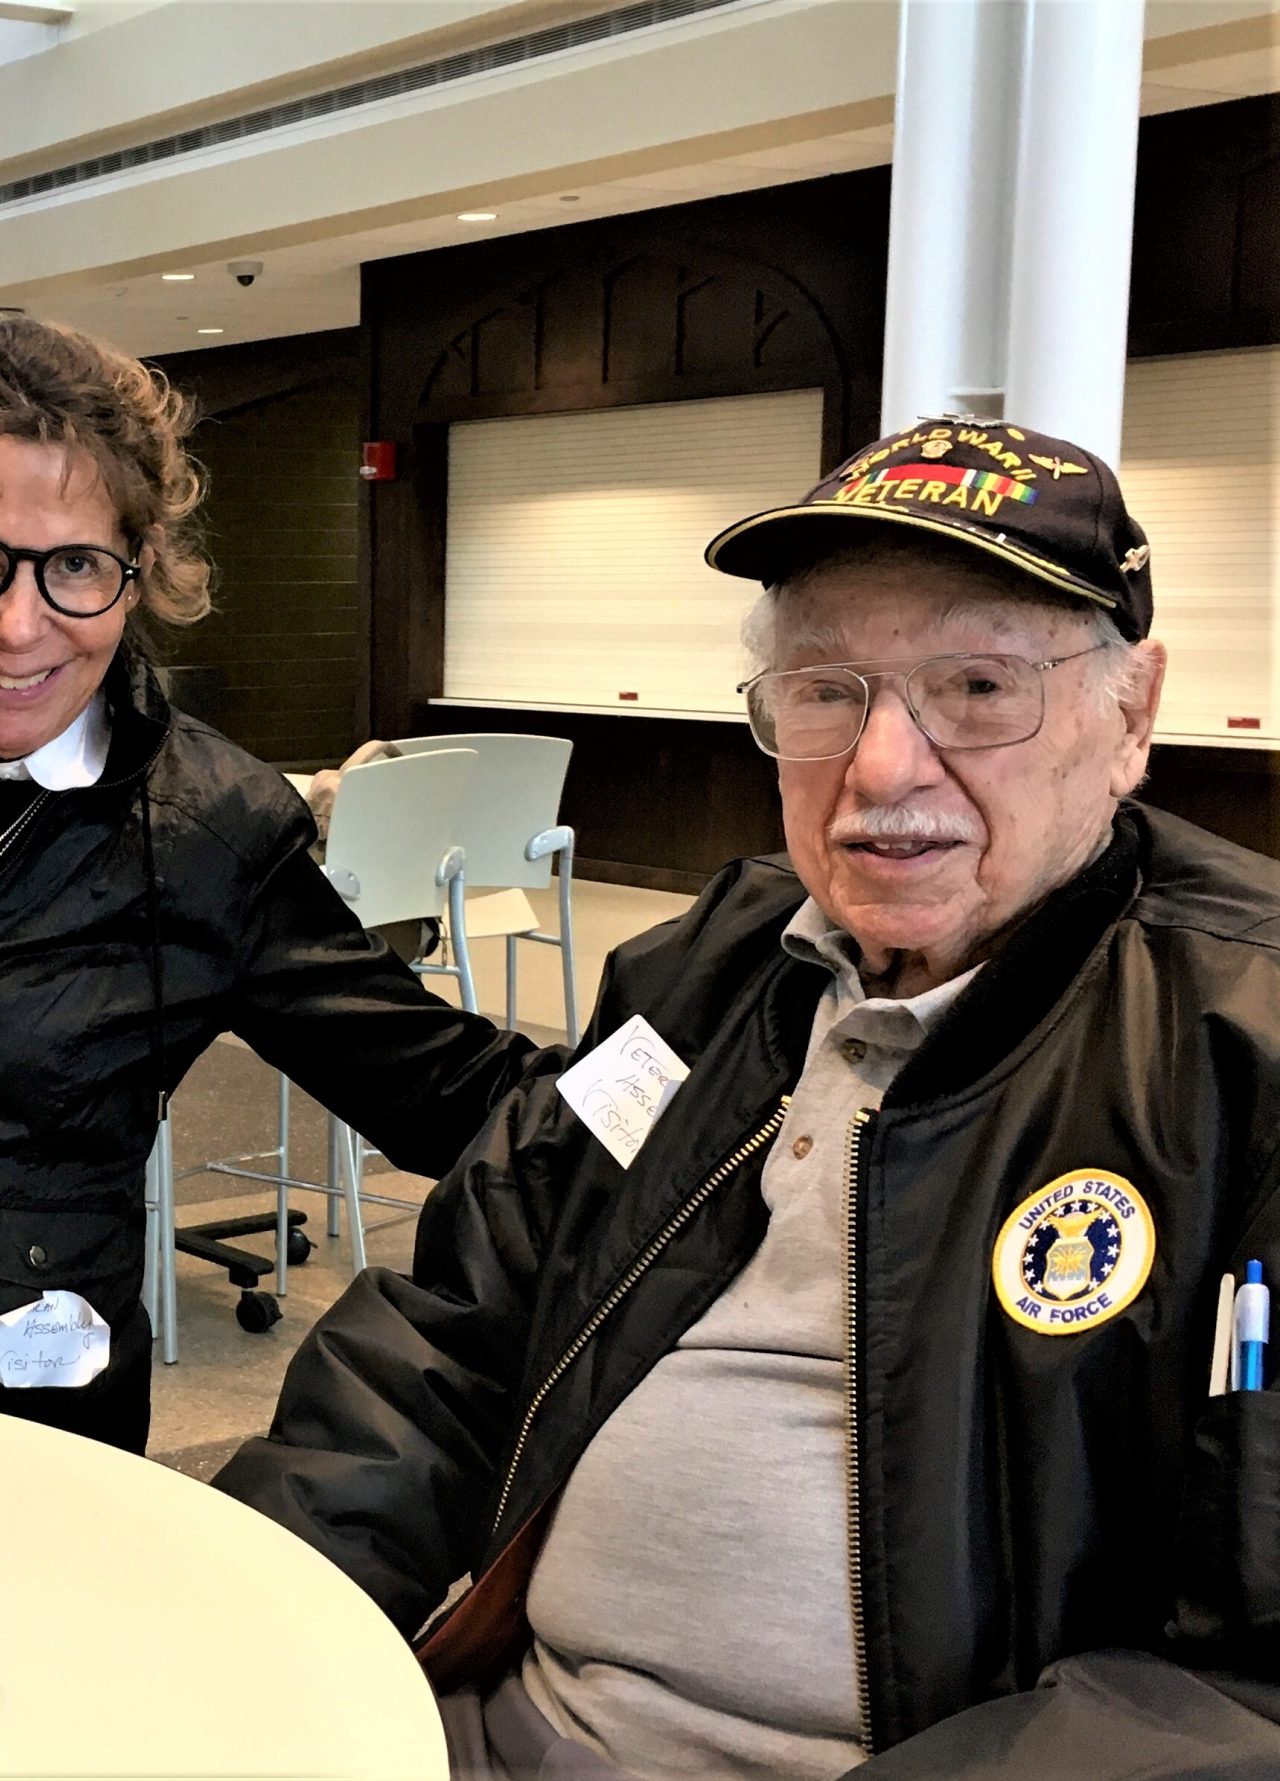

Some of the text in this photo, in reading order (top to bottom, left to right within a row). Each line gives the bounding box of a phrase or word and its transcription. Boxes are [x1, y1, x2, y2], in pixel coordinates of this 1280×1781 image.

[958, 429, 1022, 469] WAR
[833, 478, 1003, 516] VETERAN
[1018, 1180, 1136, 1231] UNITED STATES
[1015, 1293, 1113, 1323] AIR FORCE
